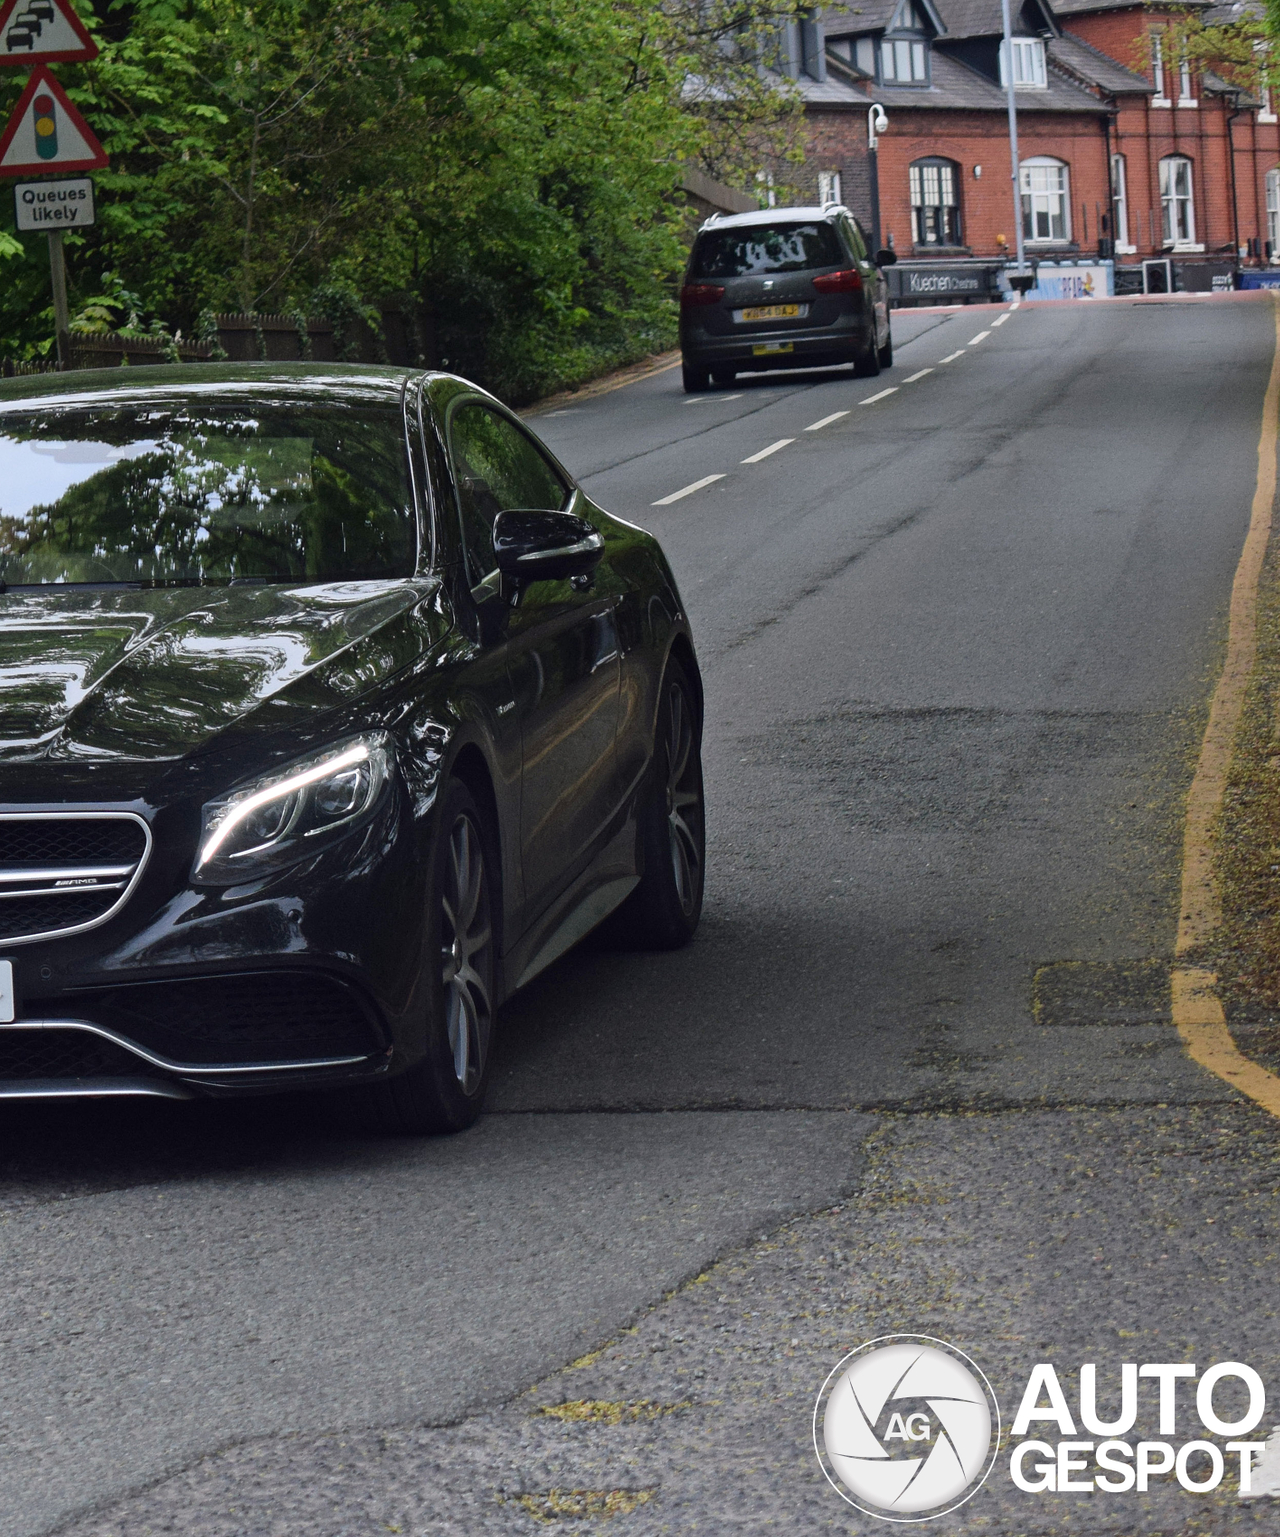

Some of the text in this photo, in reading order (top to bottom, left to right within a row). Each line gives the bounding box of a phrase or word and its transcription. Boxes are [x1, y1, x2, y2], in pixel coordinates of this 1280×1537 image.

[22, 189, 87, 205] Queues
[32, 205, 78, 221] likely
[910, 273, 951, 292] Kuechen
[66, 878, 98, 886] AMG
